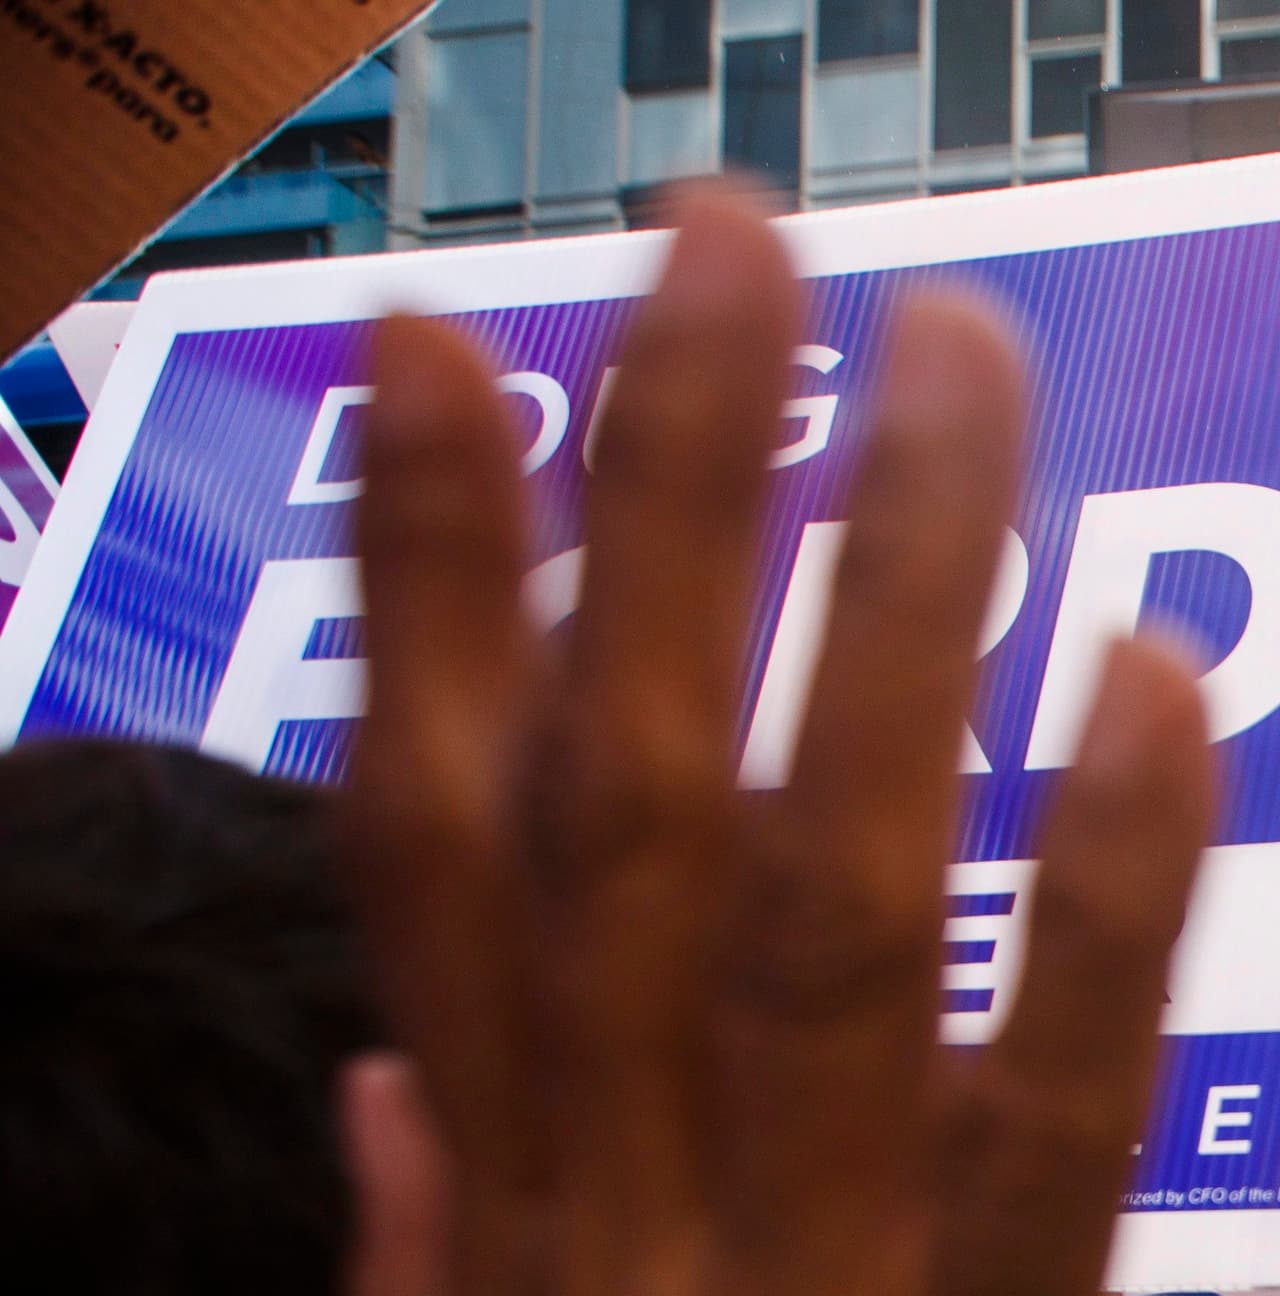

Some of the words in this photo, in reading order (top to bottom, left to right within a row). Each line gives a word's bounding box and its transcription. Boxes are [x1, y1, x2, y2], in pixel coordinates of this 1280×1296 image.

[1165, 1191, 1185, 1208] by
[1188, 1187, 1224, 1205] CFO
[1229, 1188, 1248, 1205] of
[1249, 1187, 1273, 1202] the
